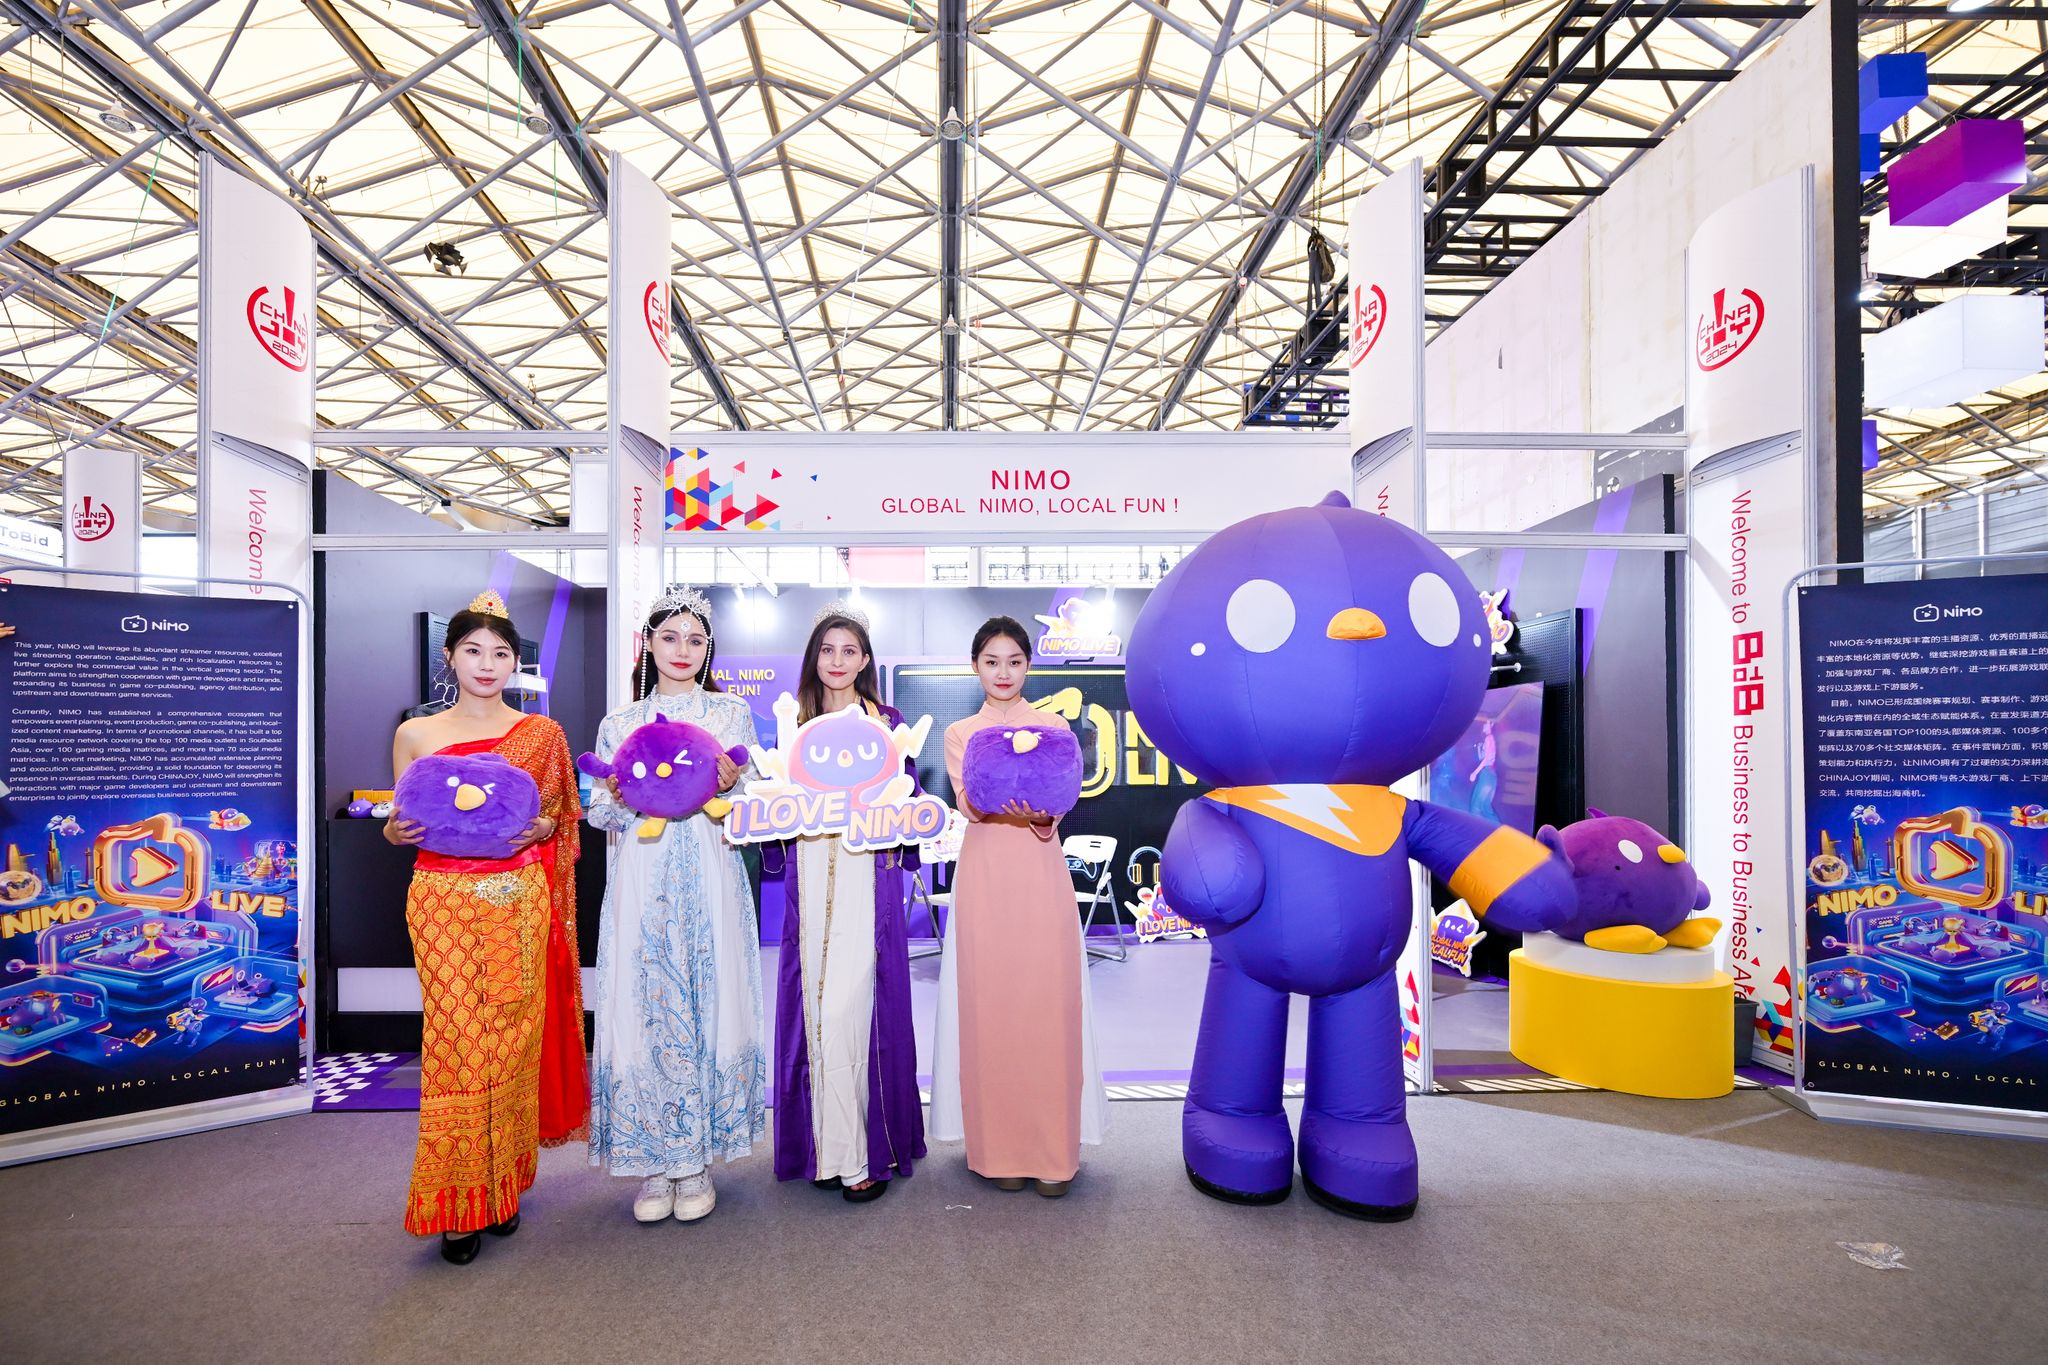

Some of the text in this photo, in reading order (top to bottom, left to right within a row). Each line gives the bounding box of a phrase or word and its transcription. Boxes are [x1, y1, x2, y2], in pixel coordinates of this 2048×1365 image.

[1706, 341, 1737, 363] 2024
[991, 470, 1071, 490] NIMO
[881, 498, 966, 513] GLOBAL
[979, 498, 1040, 515] NIMO,
[1048, 498, 1116, 513] LOCAL
[1124, 498, 1165, 513] FUN
[249, 489, 267, 594] Welcome
[632, 486, 642, 591] Welcome
[1731, 490, 1751, 596] Welcome
[1732, 603, 1750, 624] to
[98, 644, 130, 654] leverage
[1042, 638, 1080, 651] NIMO
[33, 651, 71, 661] streaming
[75, 652, 111, 662] operation
[14, 670, 46, 679] platform
[79, 671, 119, 681] strengthen
[121, 672, 164, 682] cooperation
[203, 674, 241, 684] developers
[44, 661, 73, 670] explore
[215, 666, 241, 675] gaming
[739, 669, 775, 681] NIMO
[13, 679, 55, 689] expanding
[727, 684, 760, 697] FUN!
[168, 710, 222, 719] comprehensive
[228, 710, 264, 719] ecosystem
[111, 737, 143, 745] covering
[160, 737, 172, 745] top
[132, 773, 157, 782] During
[237, 772, 273, 780] strengthen
[1733, 725, 1753, 824] Business
[9, 794, 55, 803] enterprises
[67, 793, 89, 802] jointly
[91, 792, 119, 801] explore
[731, 791, 942, 844] I LOVE NIMO
[1733, 833, 1752, 852] to
[1817, 884, 1897, 916] NIMO
[1, 889, 287, 939] NIMO LIVE
[1732, 860, 1753, 960] Business
[1146, 919, 1176, 932] LOVE
[1819, 1061, 1889, 1073] GLOBAL
[1975, 1074, 2037, 1086] LOCAL
[0, 1089, 80, 1107] GLOBAL
[171, 1067, 230, 1081] LOCAL
